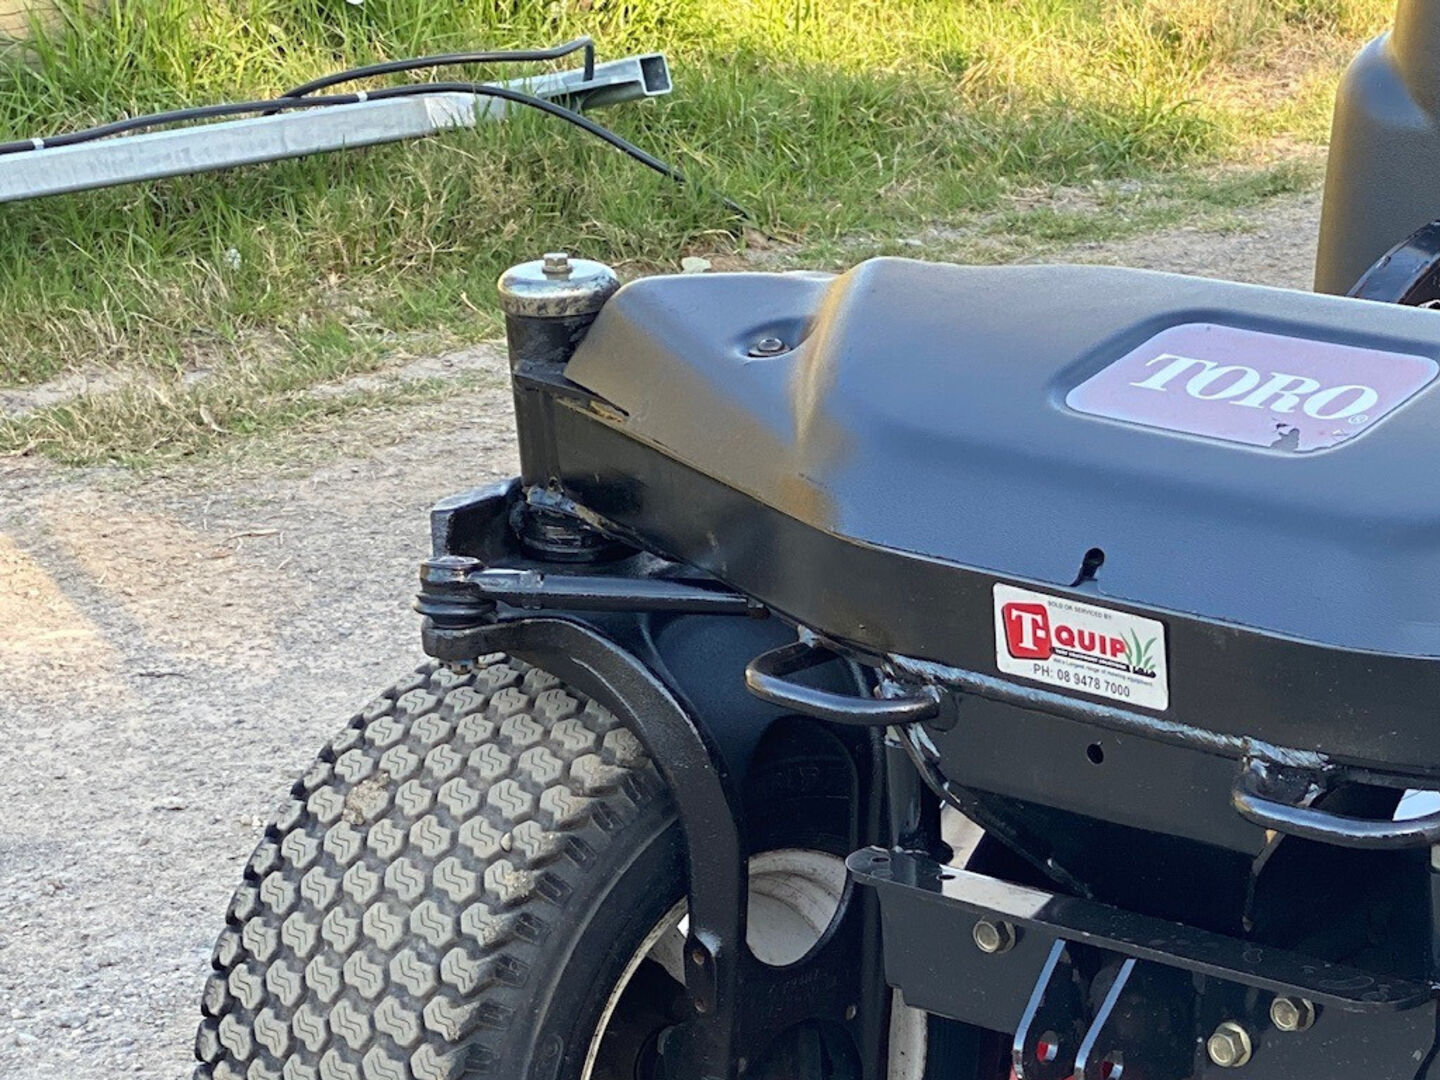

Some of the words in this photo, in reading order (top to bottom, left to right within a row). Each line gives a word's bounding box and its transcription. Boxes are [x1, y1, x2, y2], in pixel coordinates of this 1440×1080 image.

[1129, 353, 1379, 420] TORO
[1033, 663, 1053, 678] PH:
[1057, 669, 1070, 682] 08
[1075, 673, 1101, 690] 9478
[1104, 681, 1131, 698] 7000
